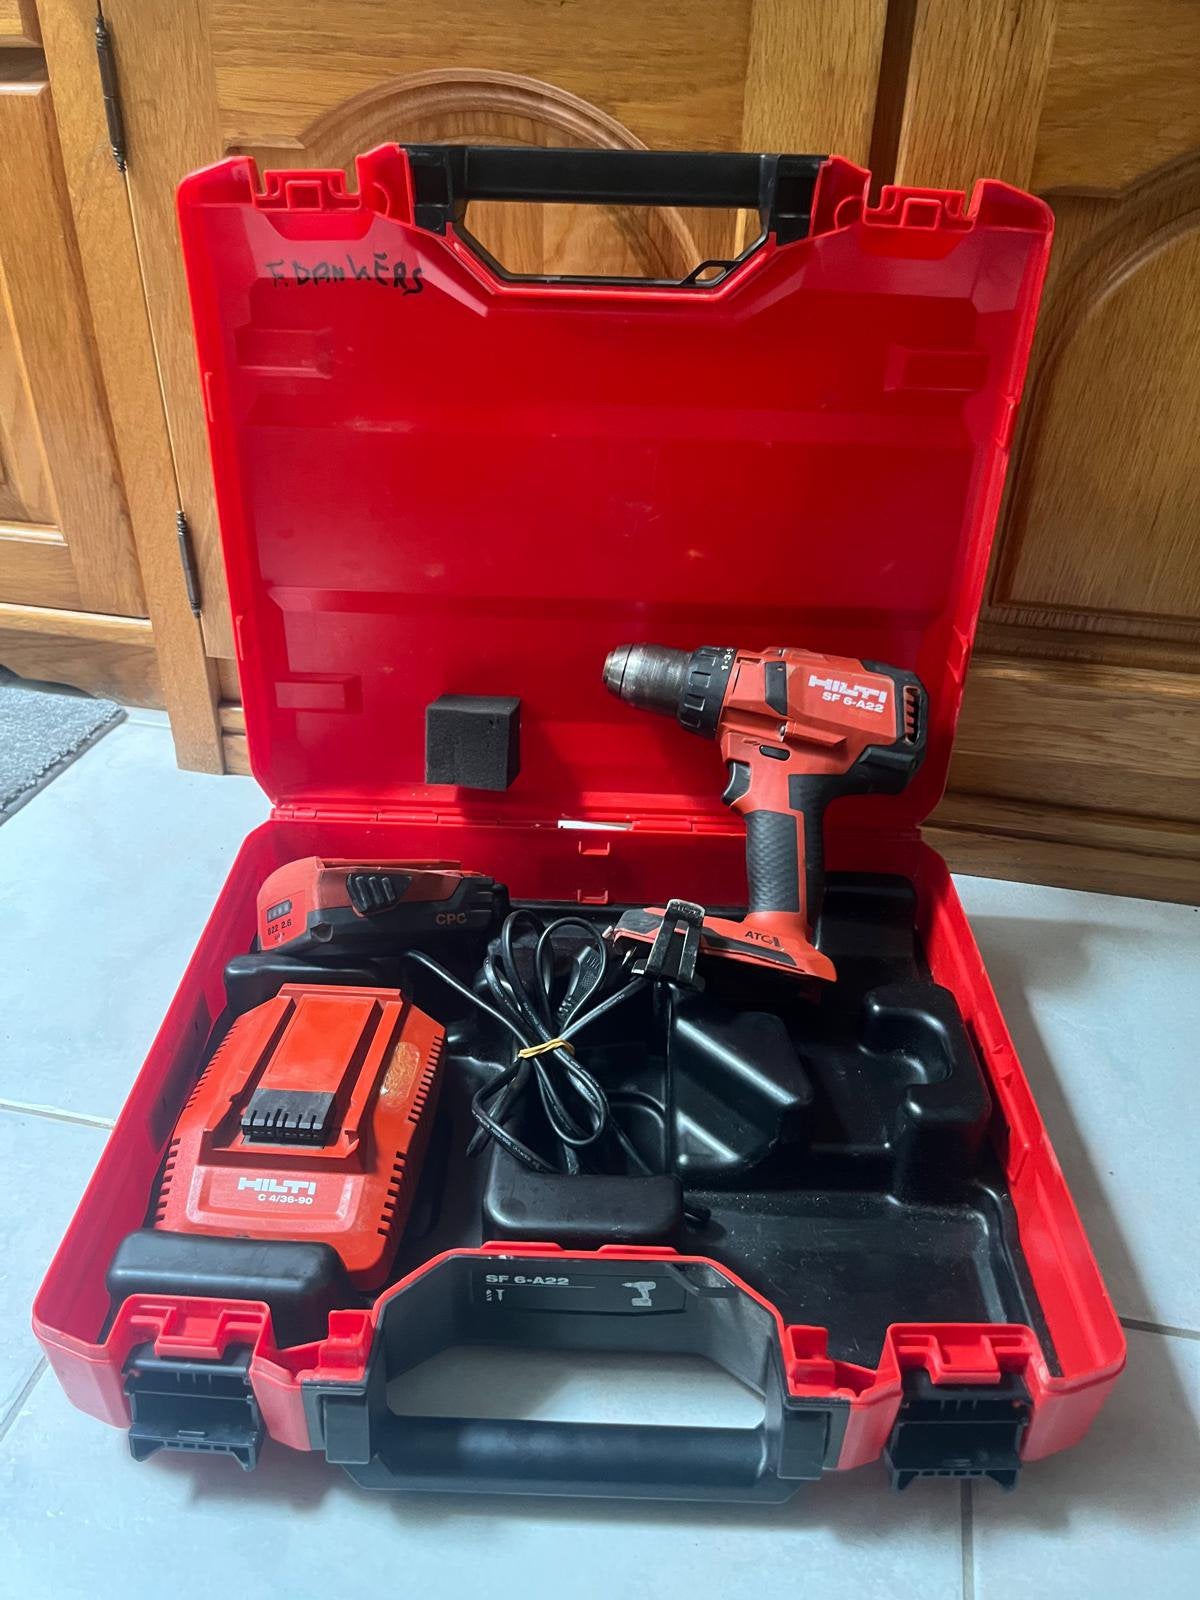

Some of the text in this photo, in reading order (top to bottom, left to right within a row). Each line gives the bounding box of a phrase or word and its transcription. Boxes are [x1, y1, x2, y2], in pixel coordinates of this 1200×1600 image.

[807, 674, 888, 704] HILTI
[822, 691, 884, 713] SF 6-A22
[435, 912, 468, 926] CPC
[237, 1176, 317, 1195] HILTI
[257, 1194, 314, 1205] C 4/36-90
[485, 1274, 569, 1286] SF 6-A22
